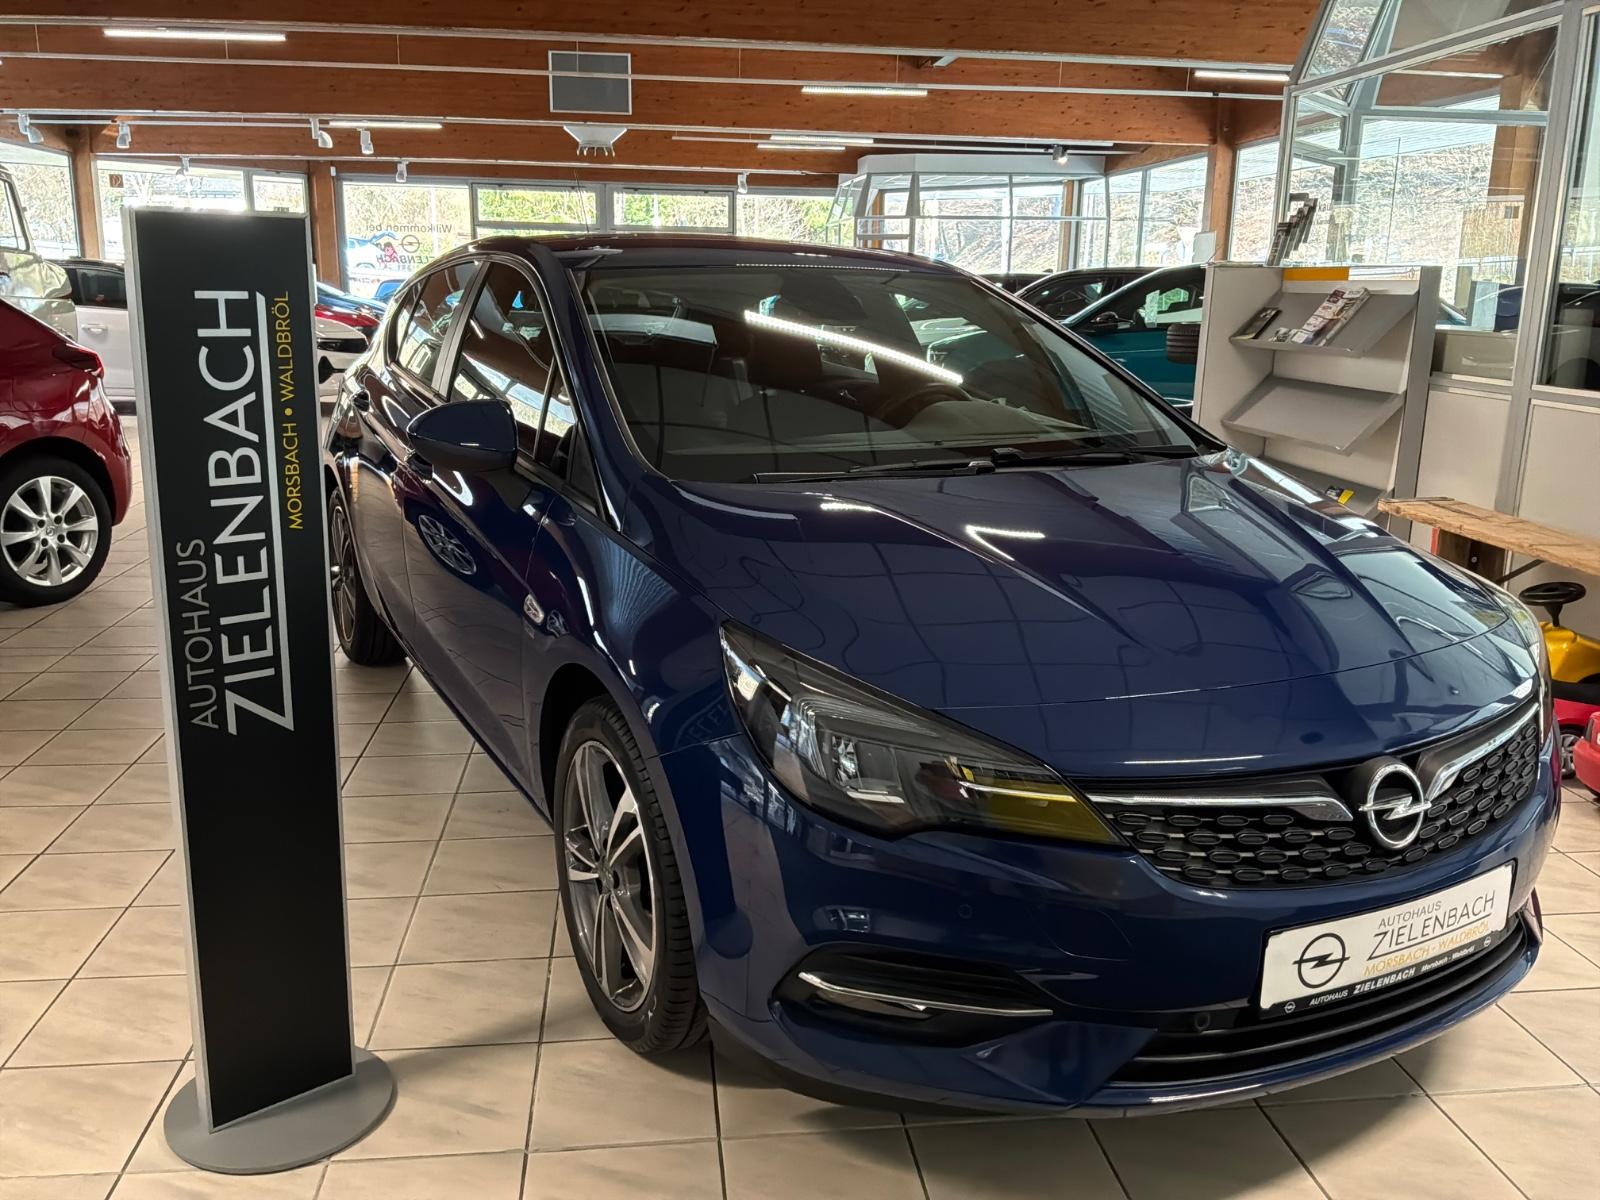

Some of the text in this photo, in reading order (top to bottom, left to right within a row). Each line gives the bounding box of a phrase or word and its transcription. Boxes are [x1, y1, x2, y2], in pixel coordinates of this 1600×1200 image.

[271, 291, 304, 530] MORSBACH WALDBRÖL
[194, 290, 295, 736] ZIELENBACH
[175, 538, 219, 729] AUTOHAUS
[1366, 889, 1496, 961] ZIELENBACH
[1378, 900, 1443, 929] AUTOHAUS
[1309, 988, 1349, 1006] AUTOHAUS
[1353, 966, 1416, 995] ZIELENBACH
[1363, 945, 1431, 978] MORSBACH
